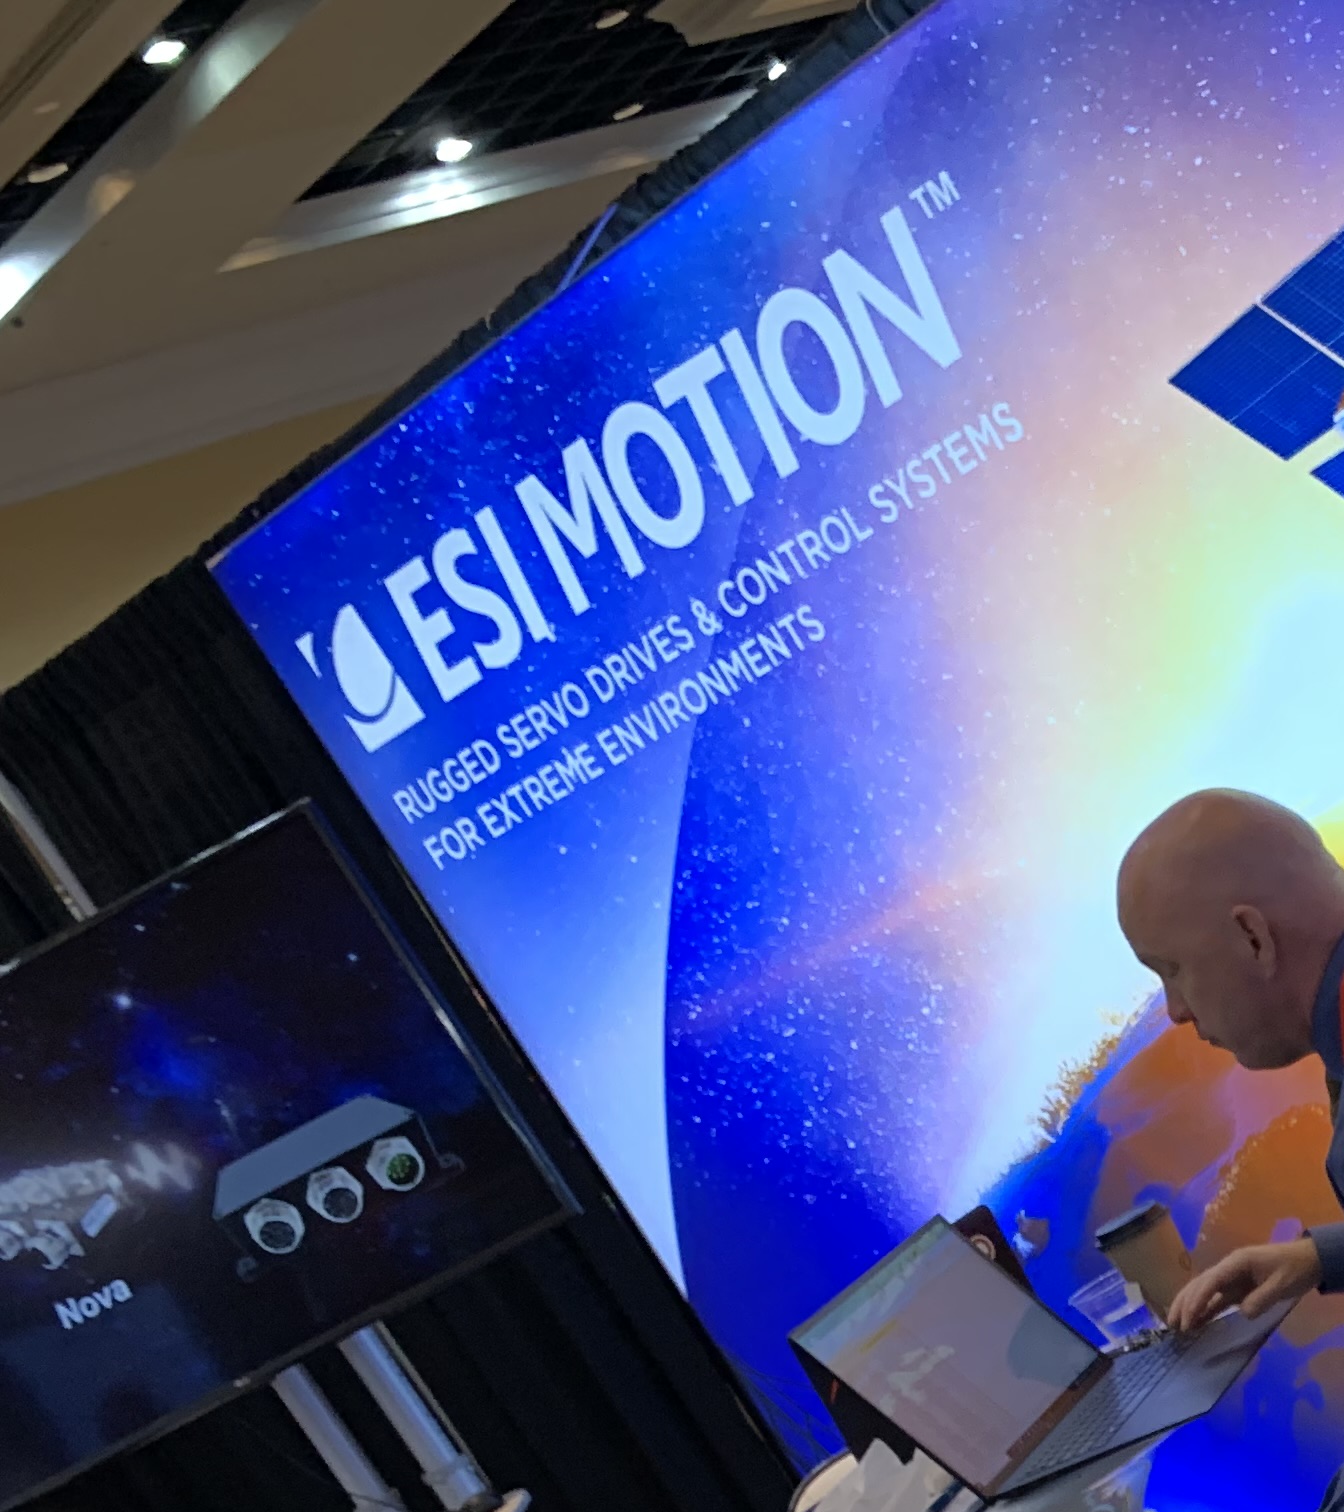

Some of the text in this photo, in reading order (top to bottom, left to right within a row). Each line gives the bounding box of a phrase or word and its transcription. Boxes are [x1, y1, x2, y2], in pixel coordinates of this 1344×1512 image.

[384, 504, 552, 703] ESI
[516, 205, 963, 616] MOTION
[393, 402, 1024, 825] RUGGED SERVO DRIVES & CONTROL SYSTEMS
[424, 605, 826, 871] FOR EXTREME ENVIRONMENTS
[54, 1278, 134, 1330] Nova
